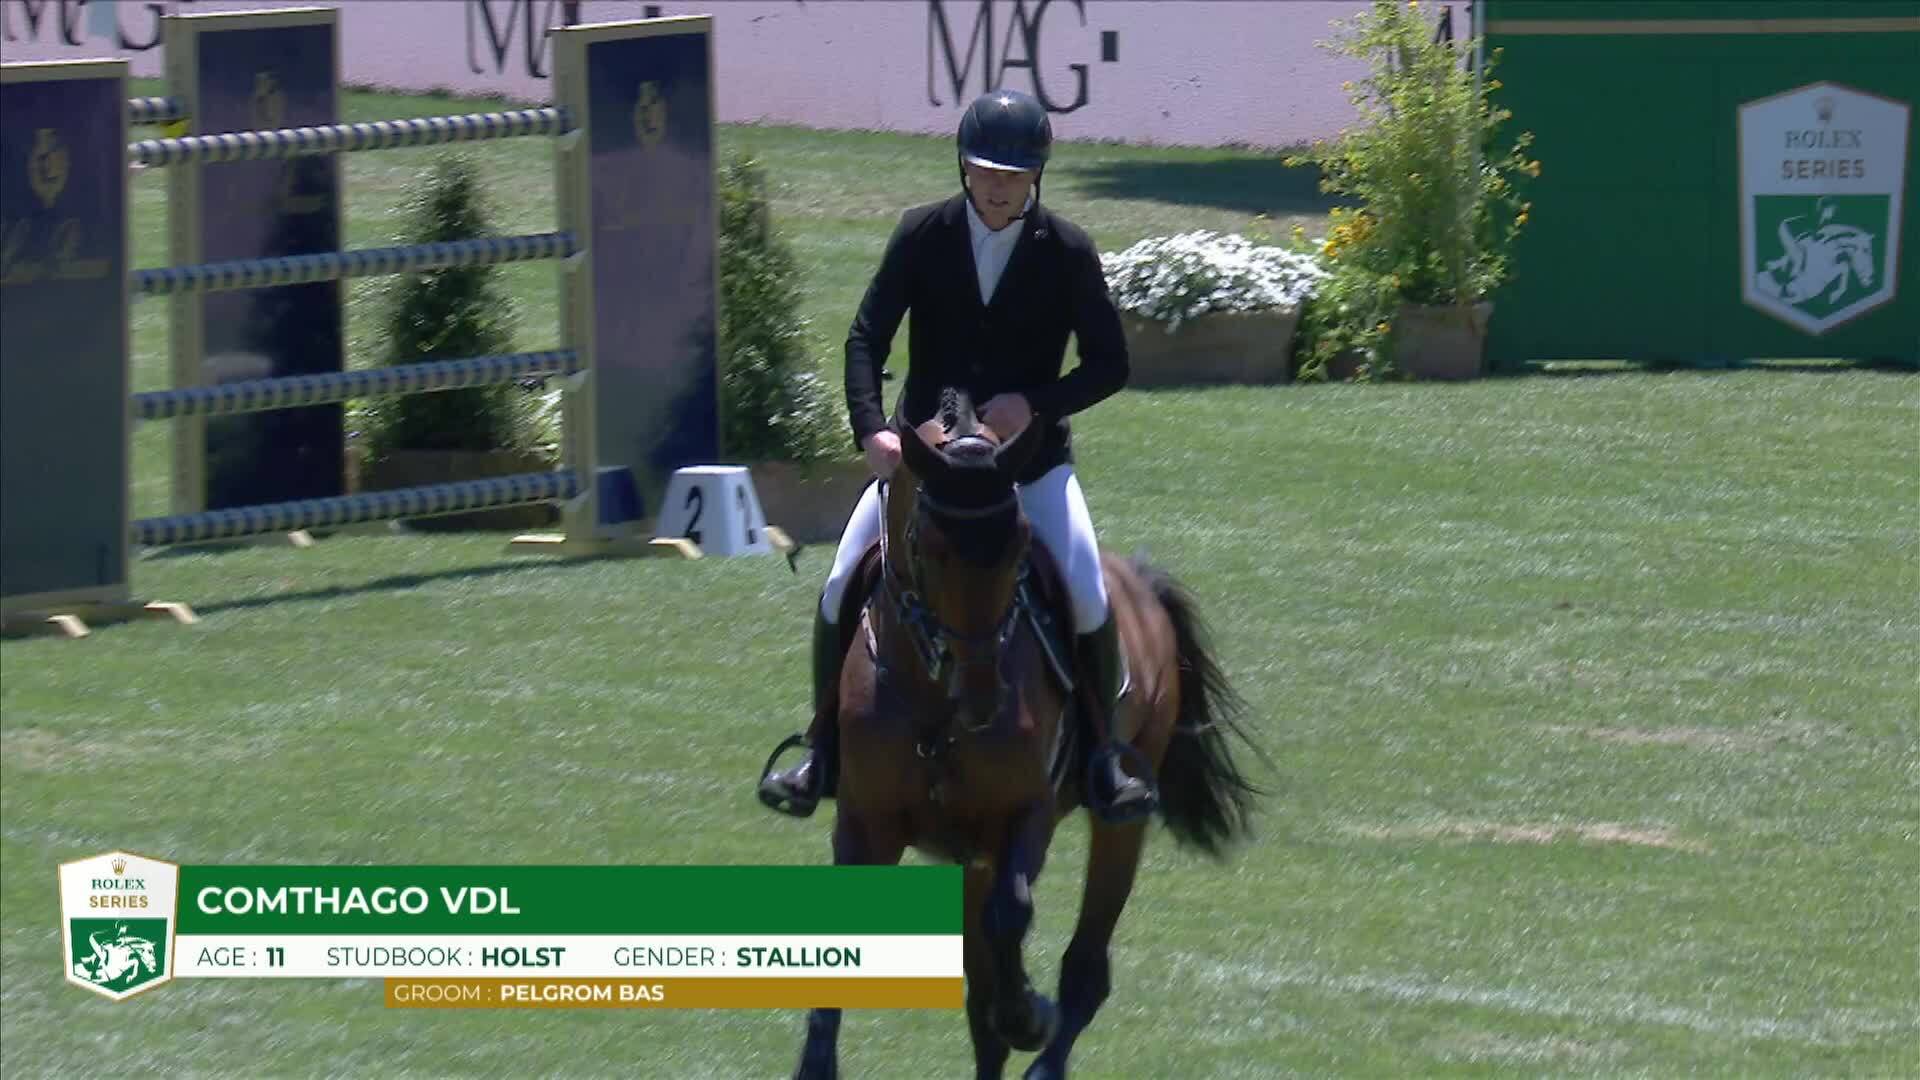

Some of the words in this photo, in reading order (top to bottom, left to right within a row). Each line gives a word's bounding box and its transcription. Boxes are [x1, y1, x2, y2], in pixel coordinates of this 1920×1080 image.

[1785, 129, 1862, 149] ROLEX
[1781, 159, 1866, 180] SERIES
[684, 485, 704, 544] 2
